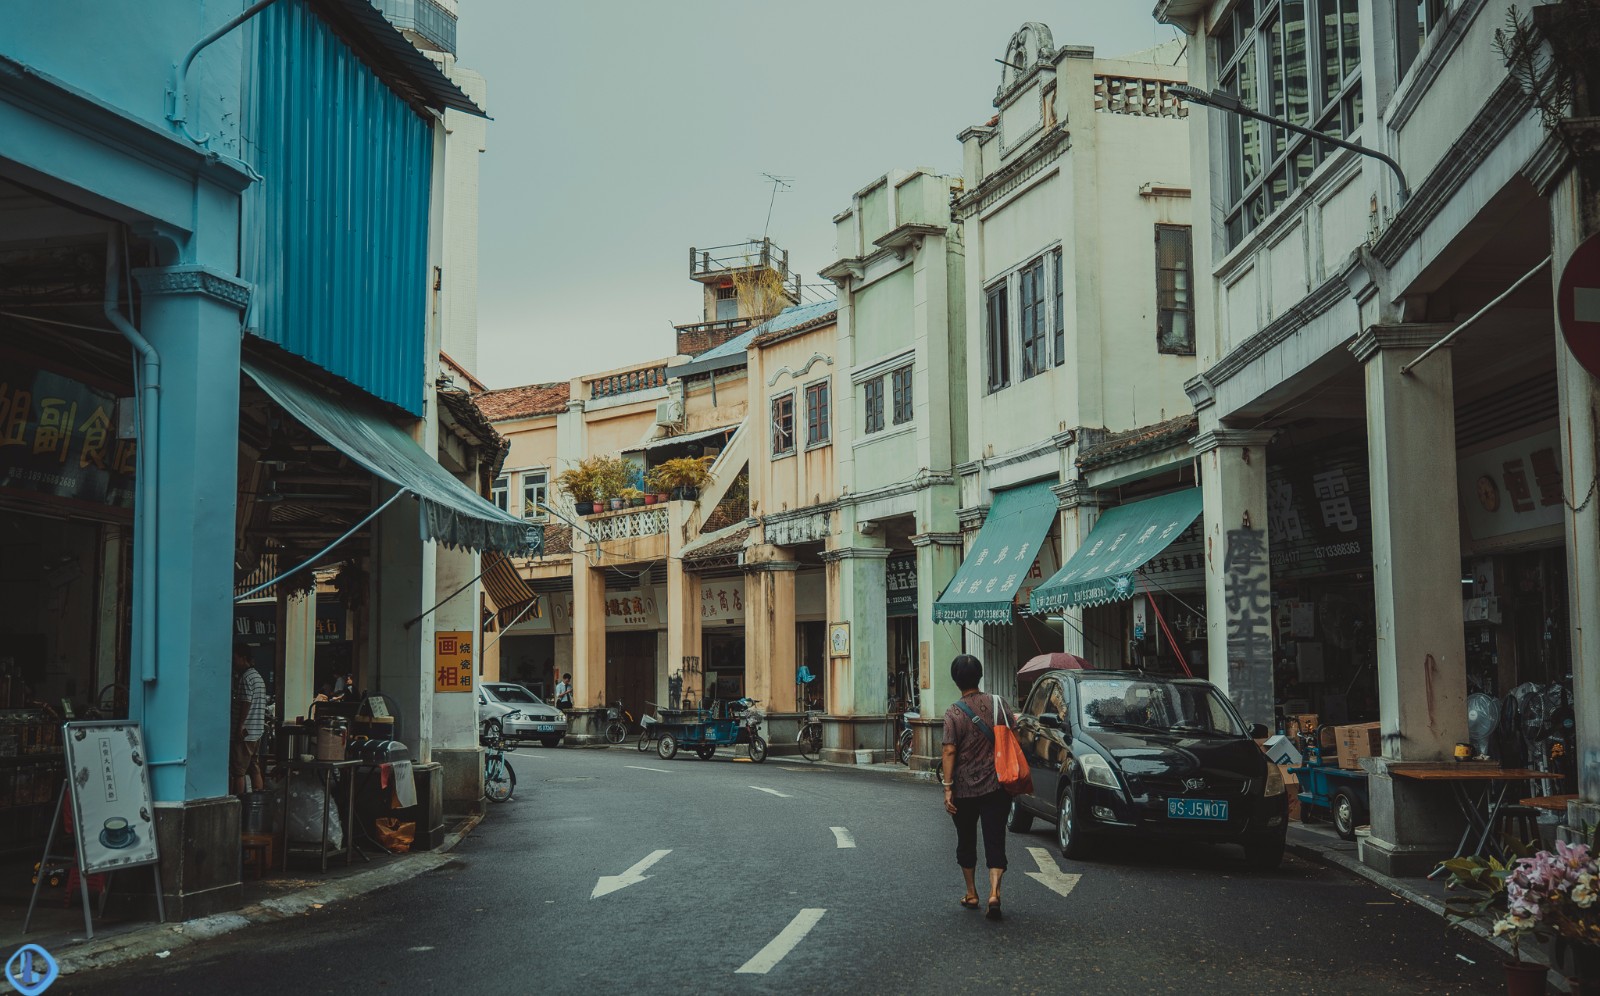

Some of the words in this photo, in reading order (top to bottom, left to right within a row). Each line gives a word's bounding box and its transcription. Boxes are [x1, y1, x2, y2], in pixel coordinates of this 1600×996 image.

[1314, 542, 1360, 559] 13713388363
[438, 637, 458, 686] 画相
[460, 643, 471, 686] 烧瓷相
